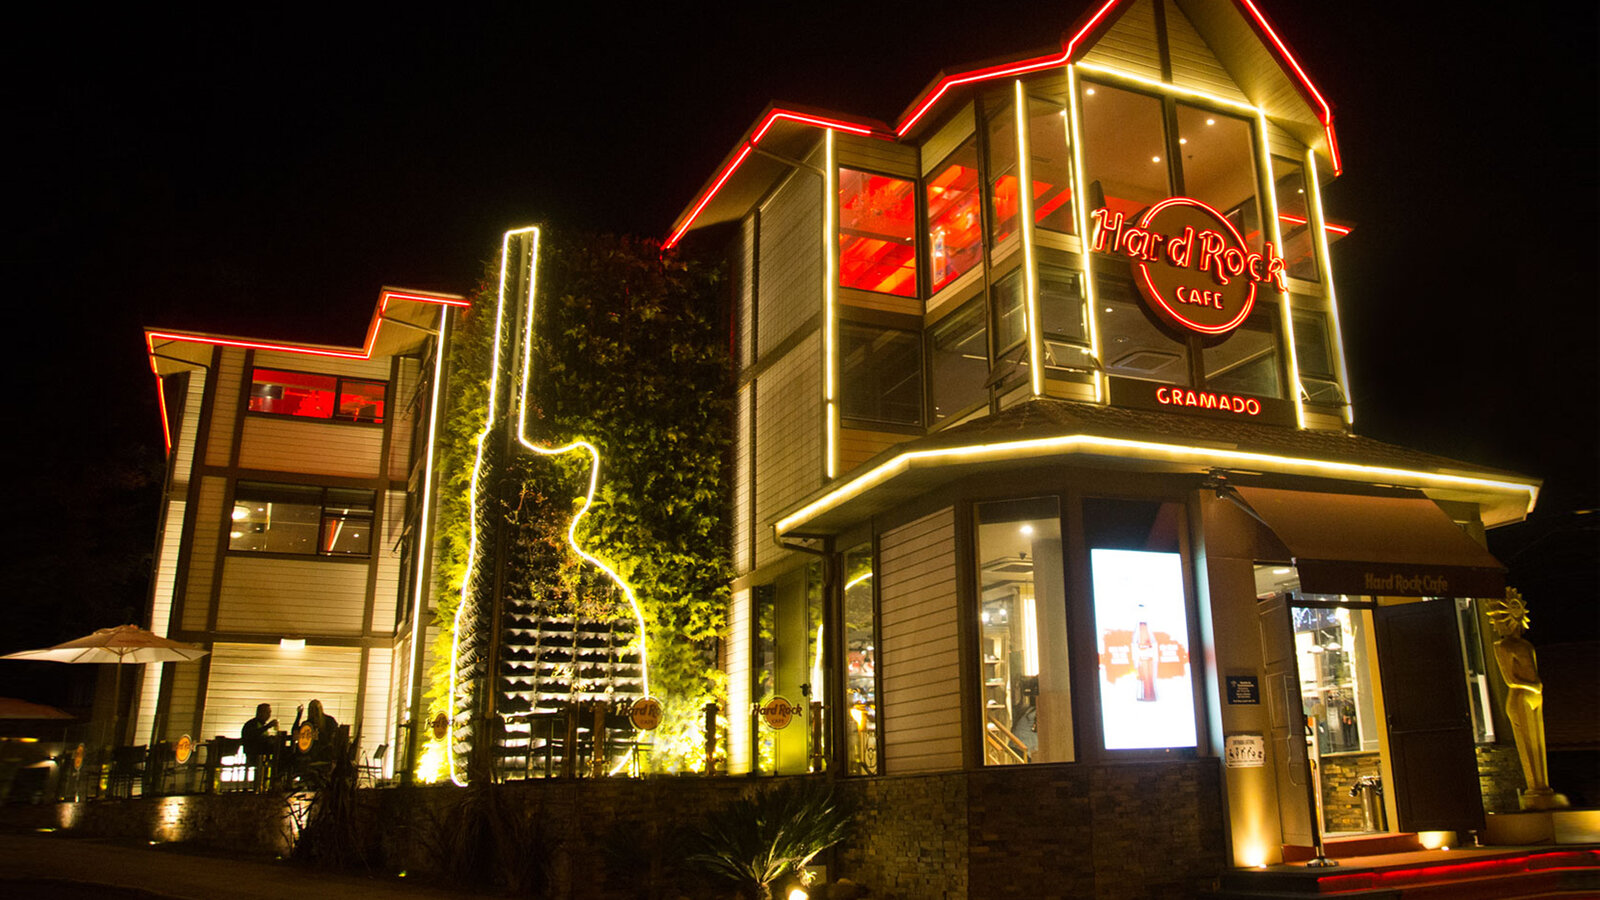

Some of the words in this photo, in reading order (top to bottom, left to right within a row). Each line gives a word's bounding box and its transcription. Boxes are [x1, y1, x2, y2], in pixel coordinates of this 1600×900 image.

[1090, 208, 1195, 268] Hard
[1198, 229, 1290, 293] Rock
[1176, 286, 1224, 310] CAFE
[1156, 387, 1262, 416] GRAMADO
[1364, 572, 1394, 590] Hard
[1395, 573, 1422, 593] Rock
[751, 703, 778, 716] Hard
[779, 703, 803, 718] Rock
